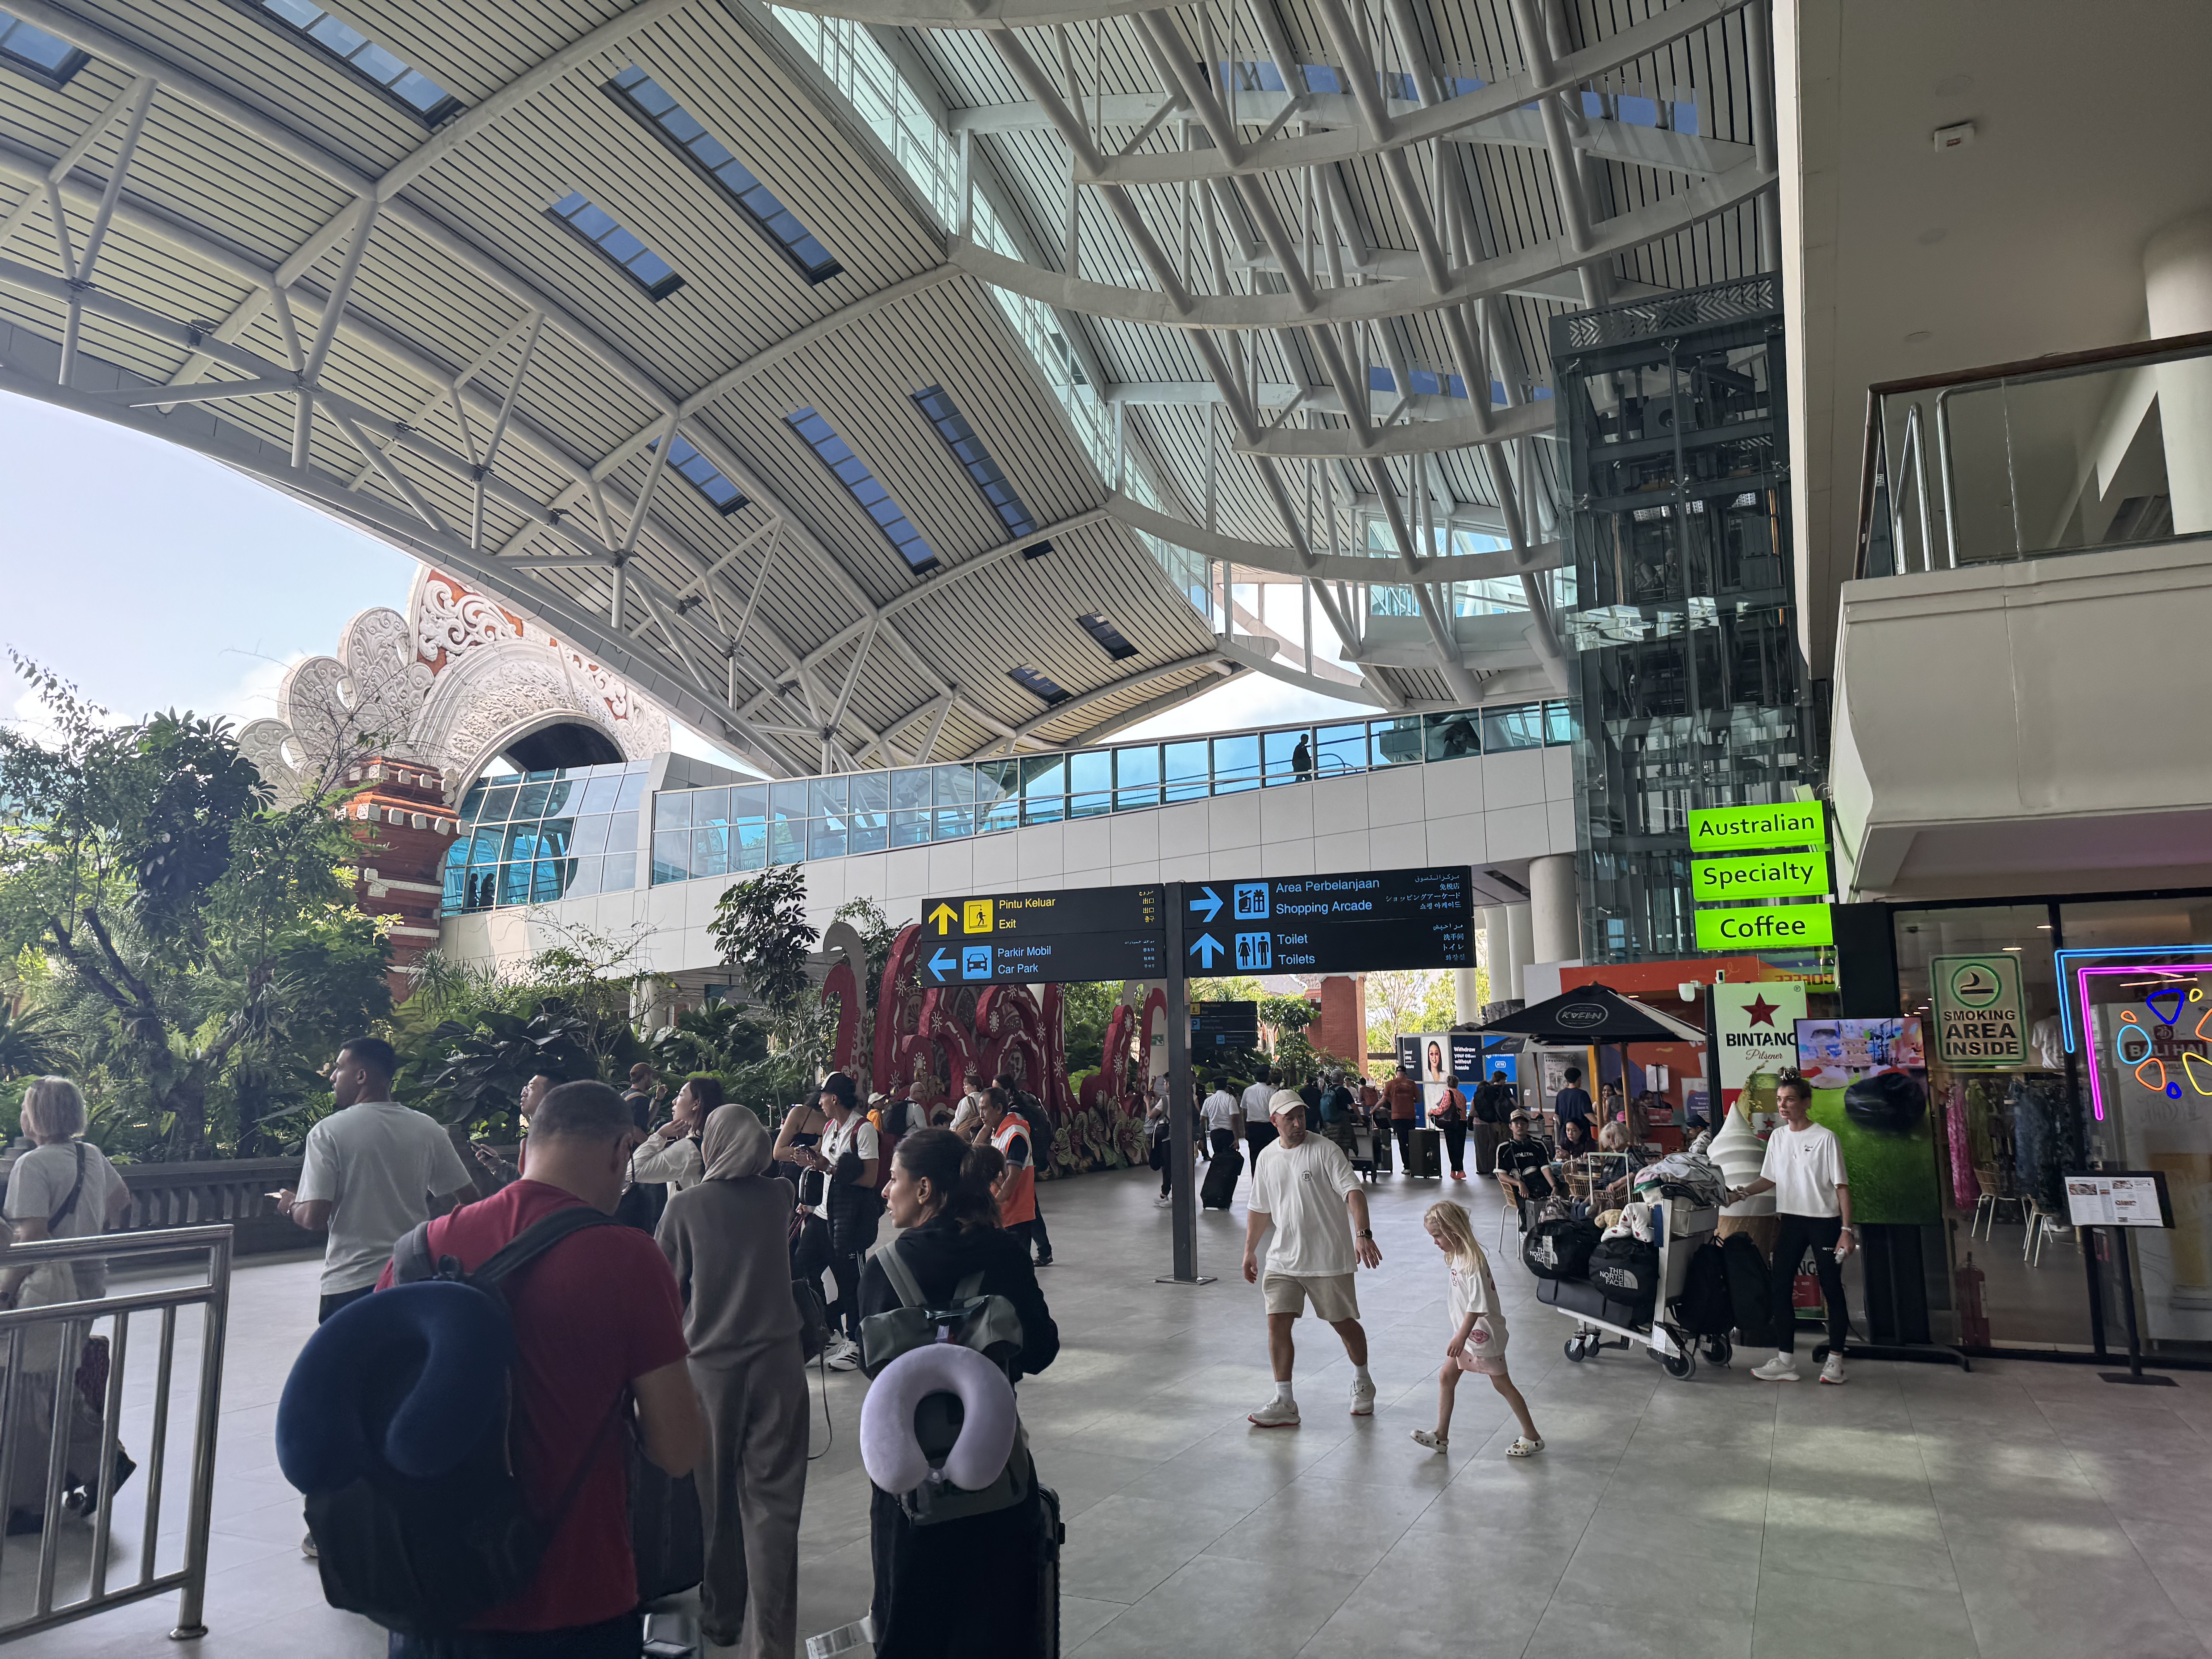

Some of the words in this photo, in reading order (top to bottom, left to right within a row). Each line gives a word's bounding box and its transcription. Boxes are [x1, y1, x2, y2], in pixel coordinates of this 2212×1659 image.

[1698, 813, 1814, 837] Australian
[1704, 861, 1814, 890] Specialty
[1276, 883, 1302, 893] Area
[1305, 879, 1380, 891] Perbelanjaan
[999, 899, 1022, 910] Pintu
[1025, 898, 1056, 908] Keluar
[1276, 902, 1328, 915] Shopping
[1332, 900, 1372, 912] Arcade
[999, 919, 1017, 929] Exit
[1720, 915, 1806, 938] Coffee
[1277, 934, 1308, 945] Toilet
[998, 947, 1024, 958] Parkir
[1027, 945, 1051, 957] Mobil
[1278, 954, 1316, 965] Toilets
[998, 964, 1015, 974] Car
[1017, 963, 1038, 974] Park
[1944, 1010, 2016, 1021] SMOKING
[1946, 1023, 2016, 1039] AREA
[1946, 1041, 2019, 1055] INSIDE
[1746, 1049, 1783, 1060] Pilsener
[1530, 1250, 1544, 1259] NORT
[1599, 1270, 1623, 1281] NORTH
[1608, 1267, 1623, 1275] THE
